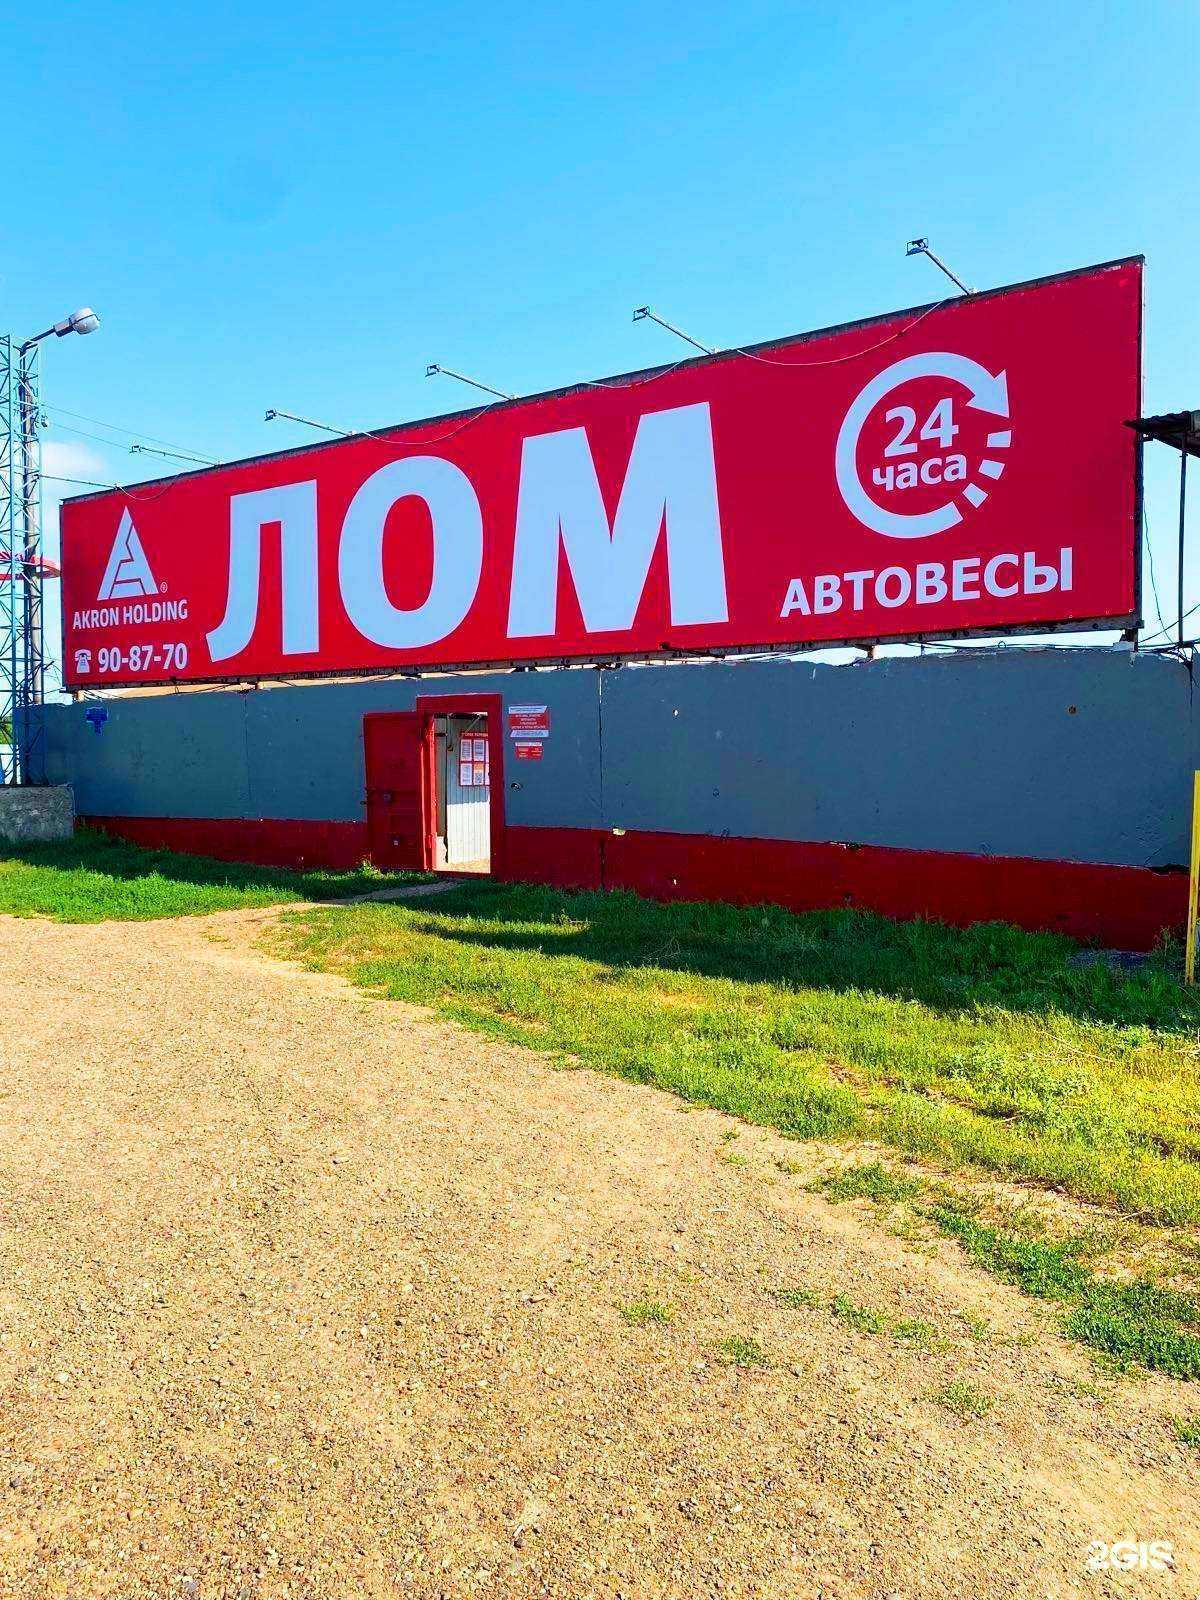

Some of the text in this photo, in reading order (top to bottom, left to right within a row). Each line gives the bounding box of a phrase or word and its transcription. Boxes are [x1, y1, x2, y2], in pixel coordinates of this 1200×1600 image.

[884, 397, 959, 458] 24
[872, 453, 967, 492] часа
[206, 402, 730, 663] ЛОМ
[779, 547, 1074, 618] АВТОВЕСЫ
[72, 600, 188, 630] AKRON HOLDING
[97, 642, 189, 673] 90-87-70
